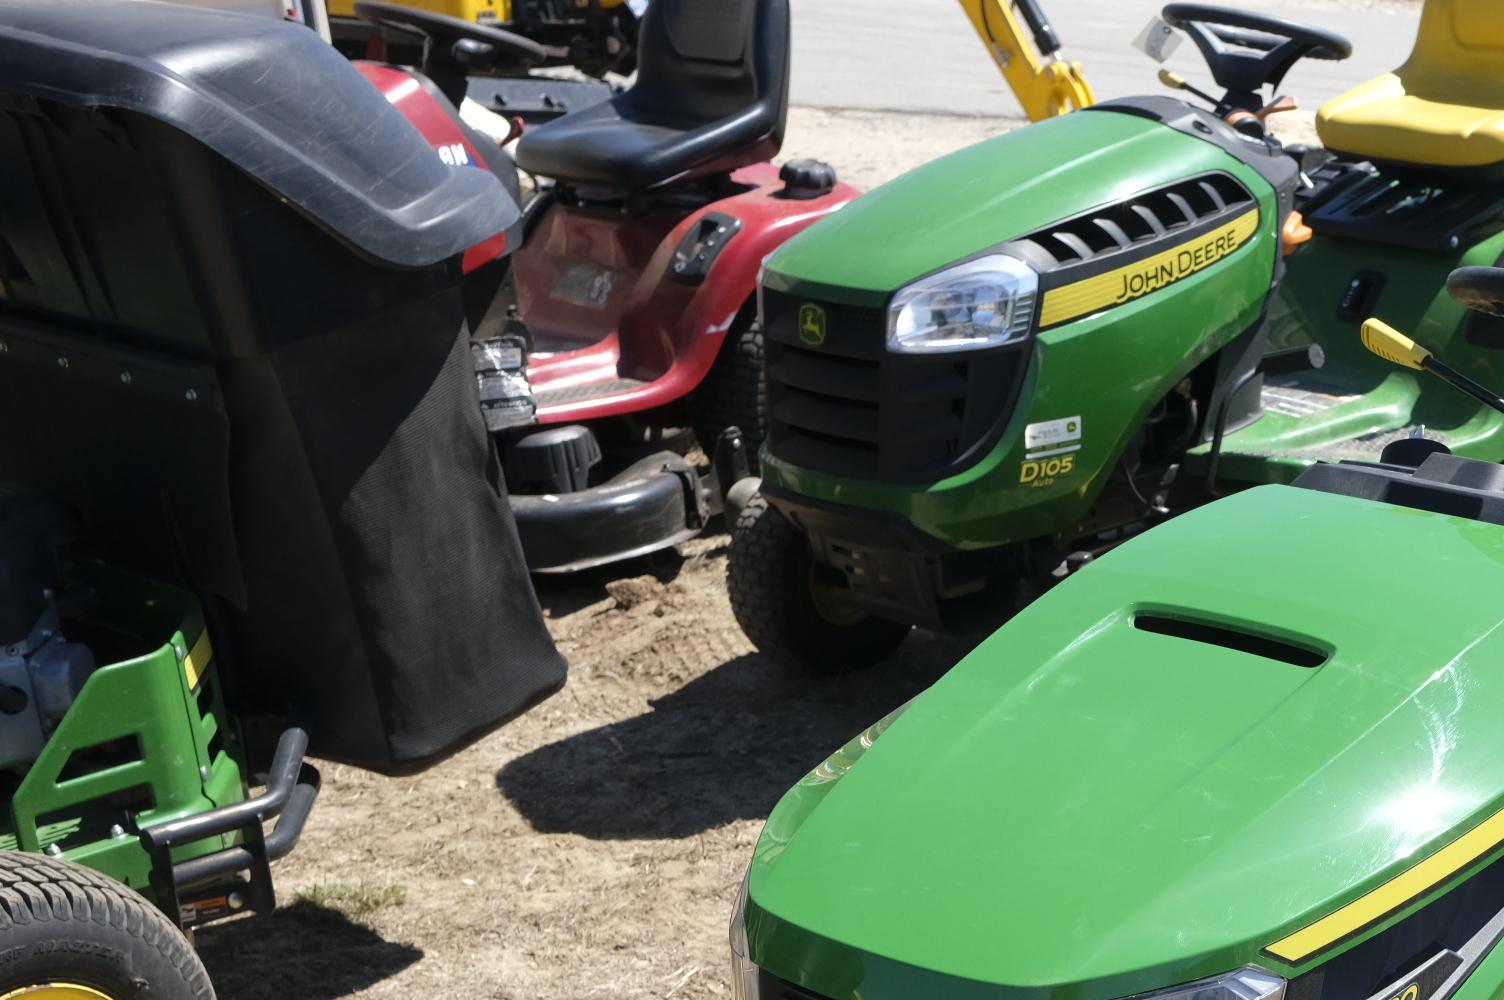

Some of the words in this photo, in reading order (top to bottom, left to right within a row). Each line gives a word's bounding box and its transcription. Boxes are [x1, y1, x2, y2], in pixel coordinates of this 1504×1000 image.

[1116, 260, 1173, 300] JOHN
[1177, 228, 1237, 275] DEERE
[1020, 456, 1074, 483] D105
